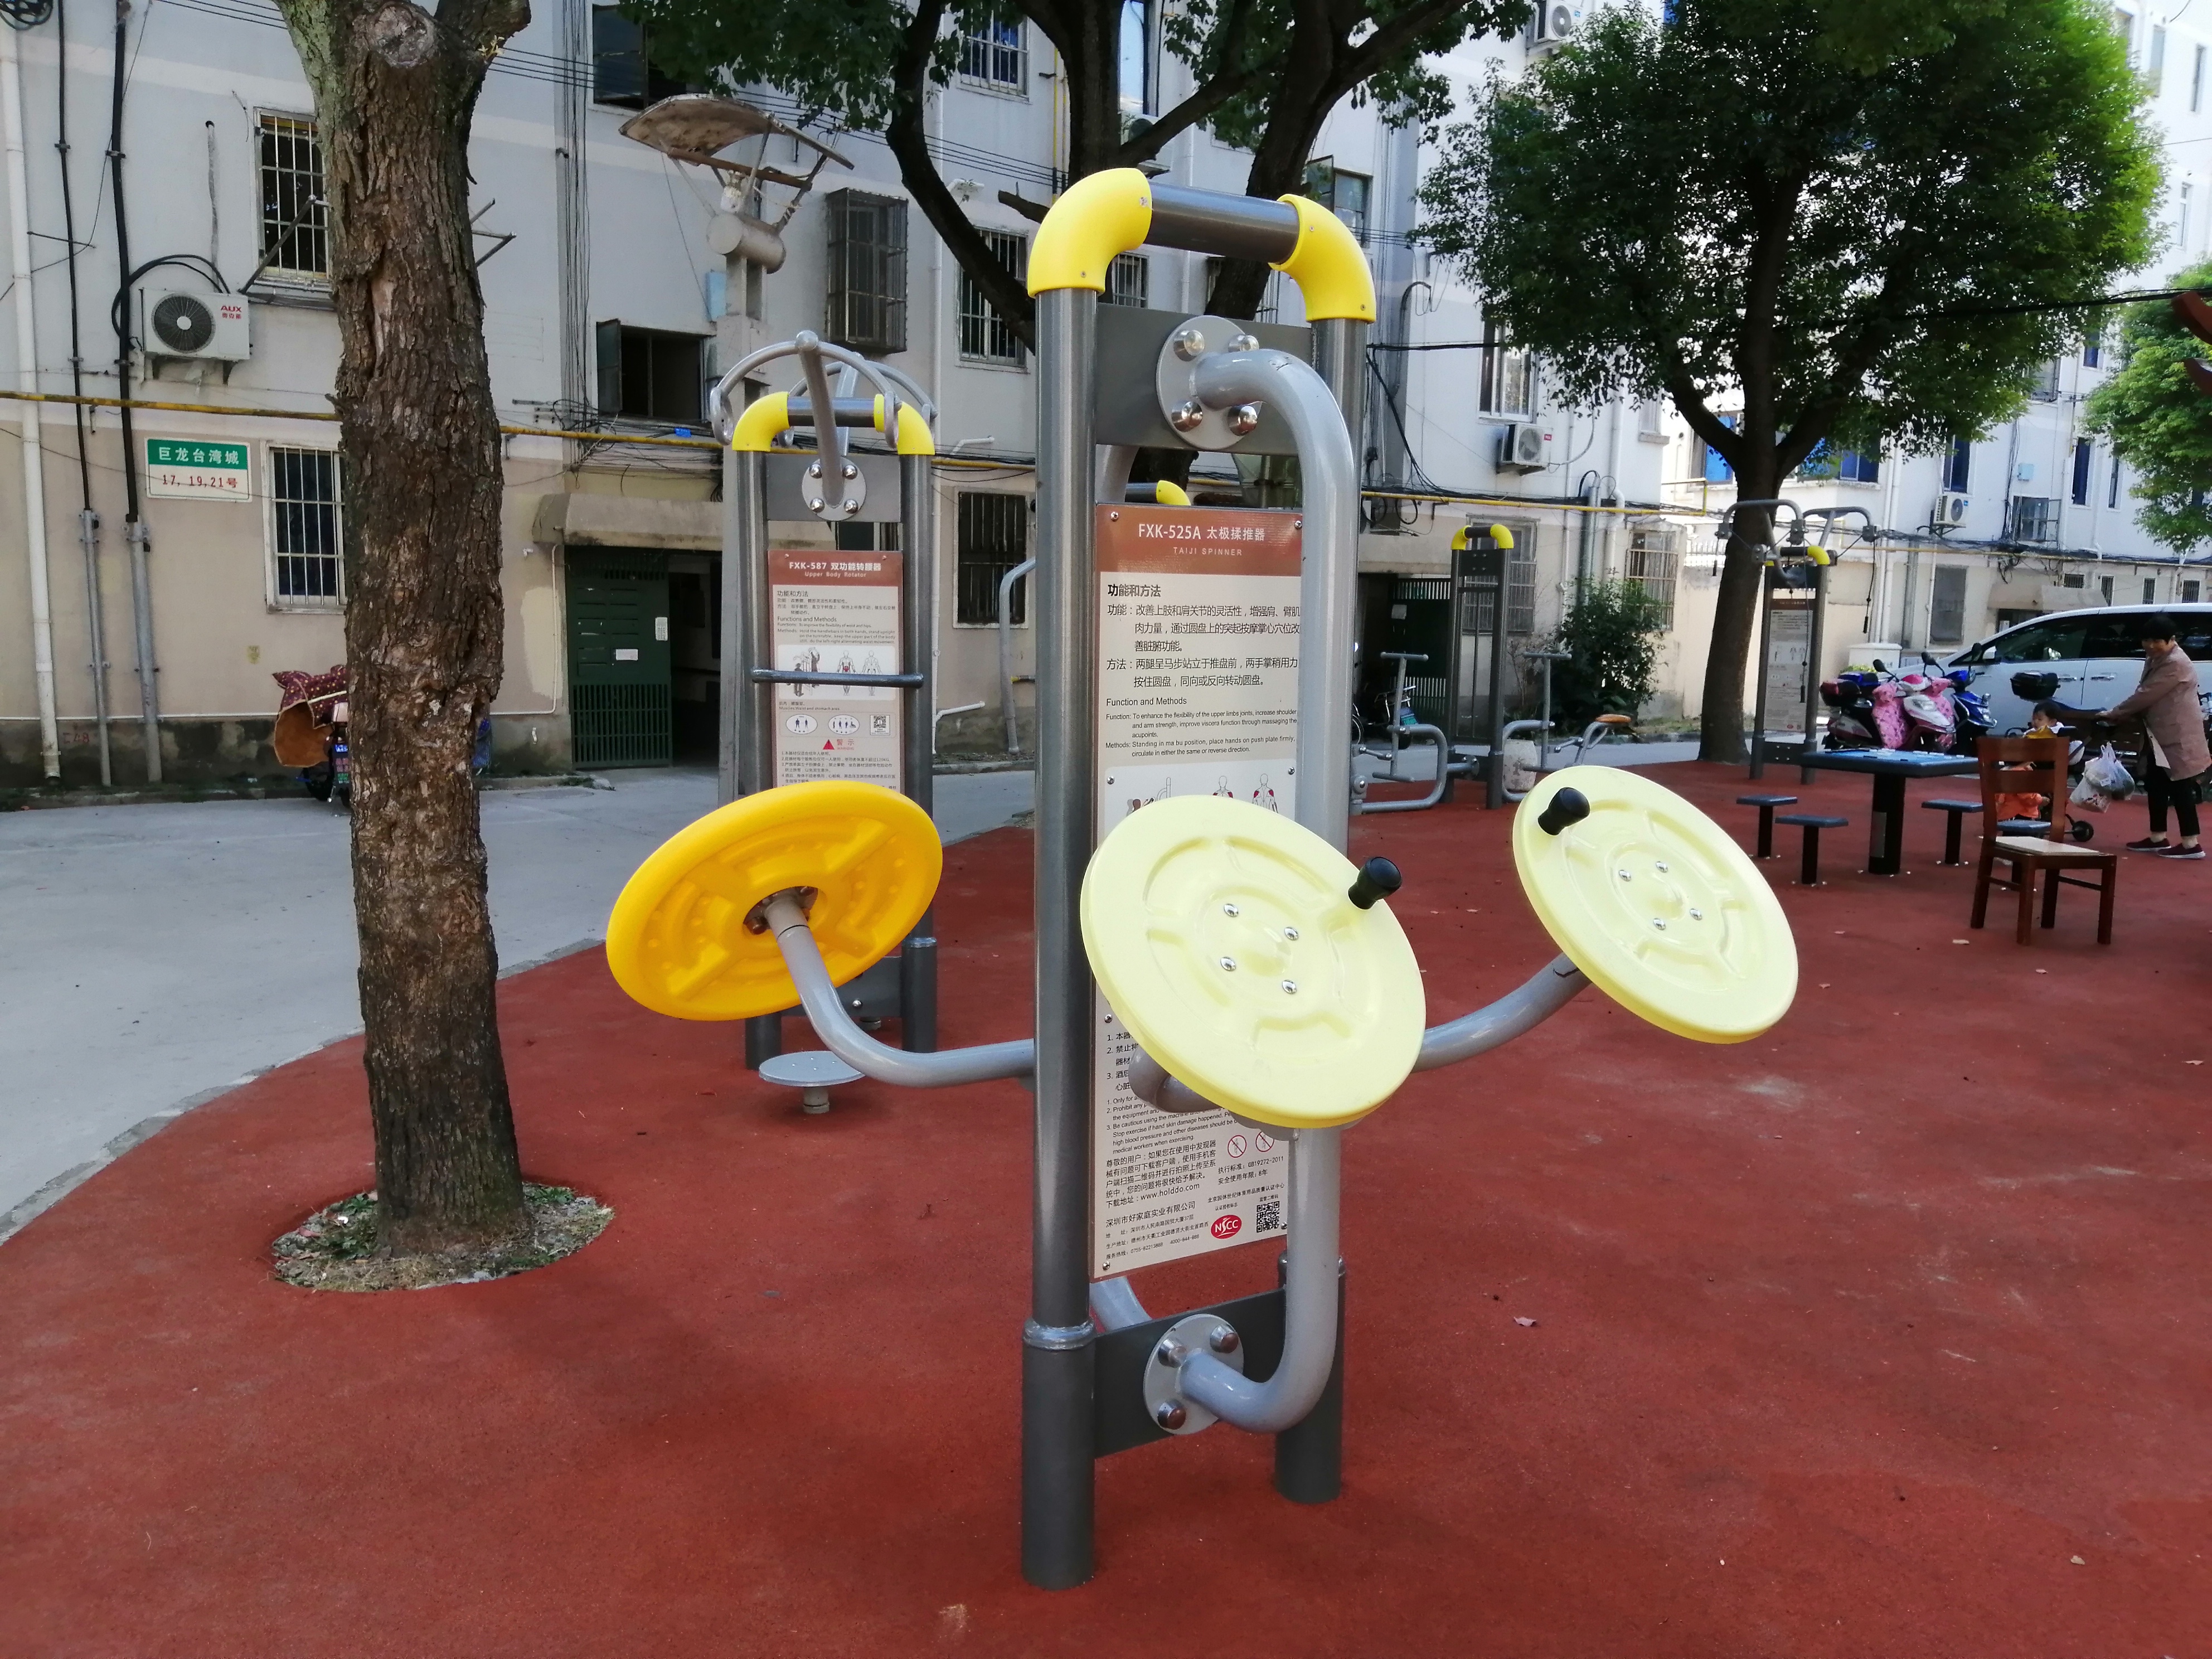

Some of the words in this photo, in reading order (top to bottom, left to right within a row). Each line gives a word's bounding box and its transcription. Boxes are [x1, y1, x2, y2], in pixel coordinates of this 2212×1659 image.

[159, 447, 239, 465] 巨龙台湾城
[162, 474, 180, 487] 17,
[1138, 523, 1201, 540] FXK-525A
[1206, 526, 1265, 542] 太极揉推器
[831, 562, 881, 571] 双功能转腰器
[1108, 584, 1161, 598] 功能和方法
[1135, 622, 1300, 635] 肉力量，通过圆盘上的突起按摩掌心穴位改
[1134, 641, 1183, 653] 善脏腑功能。
[1134, 675, 1264, 688] 按住圆盘，同向或反向转动圆盘。
[1106, 698, 1138, 706] Function
[1156, 697, 1187, 705] Methods
[1122, 1110, 1149, 1119] equipment
[1198, 1113, 1223, 1122] happened.
[1121, 1119, 1143, 1128] cautious
[1140, 1133, 1162, 1142] pressure
[1187, 1124, 1209, 1132] diseases
[1106, 1139, 1216, 1167] 尊敬的用户：如果您在使用中发现器
[1113, 1146, 1133, 1154] medical
[1106, 1149, 1216, 1178] 械有问题可下载客户端，使用手机客
[1105, 1159, 1216, 1188] 户端扫描二维码并进行拍照上传至系
[1106, 1172, 1205, 1199] 统中，您的问题将很快给予解决。
[1207, 1183, 1284, 1203] 北京国体世纪体育用品质量认证中心
[1106, 1201, 1196, 1228] 深圳市好家庭实业有限公司
[1215, 1217, 1239, 1234] NSCC
